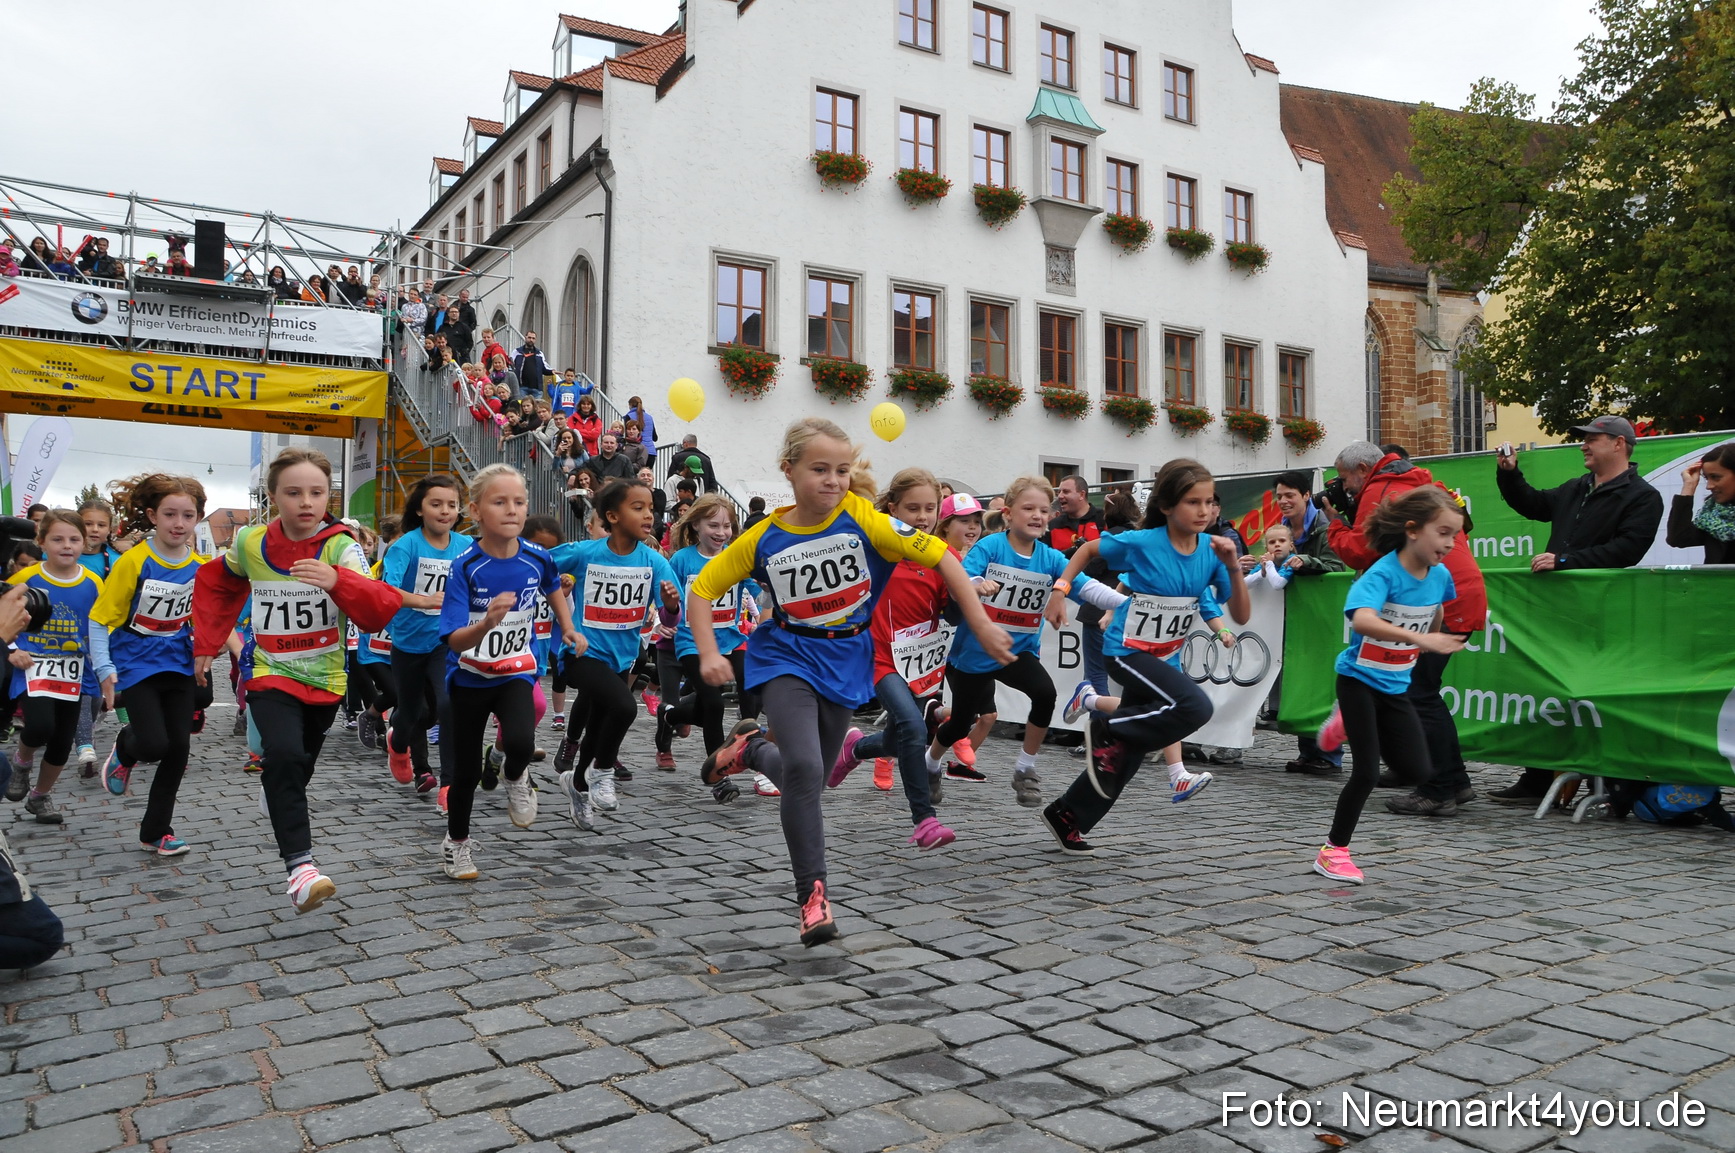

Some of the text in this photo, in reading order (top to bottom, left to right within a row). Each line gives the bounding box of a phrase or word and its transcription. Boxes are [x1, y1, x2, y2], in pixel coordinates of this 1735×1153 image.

[117, 299, 317, 331] BMW EfficientDynamics
[117, 315, 165, 329] Weniger
[167, 320, 225, 335] Verbrauch.
[228, 327, 255, 337] Mehr
[11, 367, 105, 383] Neumarkter Stadtlauf
[129, 362, 266, 401] START
[288, 391, 367, 402] Neumarkter Stadtlauf
[16, 466, 44, 519] Audi BKK
[768, 542, 846, 568] PARTL Neumarkt
[1466, 534, 1534, 558] men
[419, 562, 440, 571] PARTL
[587, 569, 609, 579] PARTL
[779, 554, 860, 598] 7203
[988, 568, 1045, 586] PARTL Neumarkt
[145, 584, 170, 595] PARTL
[254, 588, 323, 597] PARTL Neumarkt
[423, 572, 448, 593] 70
[592, 580, 645, 606] 7504
[811, 596, 846, 614] Mona
[990, 579, 1046, 611] 7183
[1132, 599, 1156, 610] PARTL
[260, 598, 329, 631] 7151
[996, 611, 1025, 624] Kristin
[1135, 611, 1193, 639] 7149
[276, 636, 315, 651] Selina
[893, 637, 943, 655] PARTL Neumarkt
[33, 659, 80, 680] 7219
[900, 644, 947, 679] 7123
